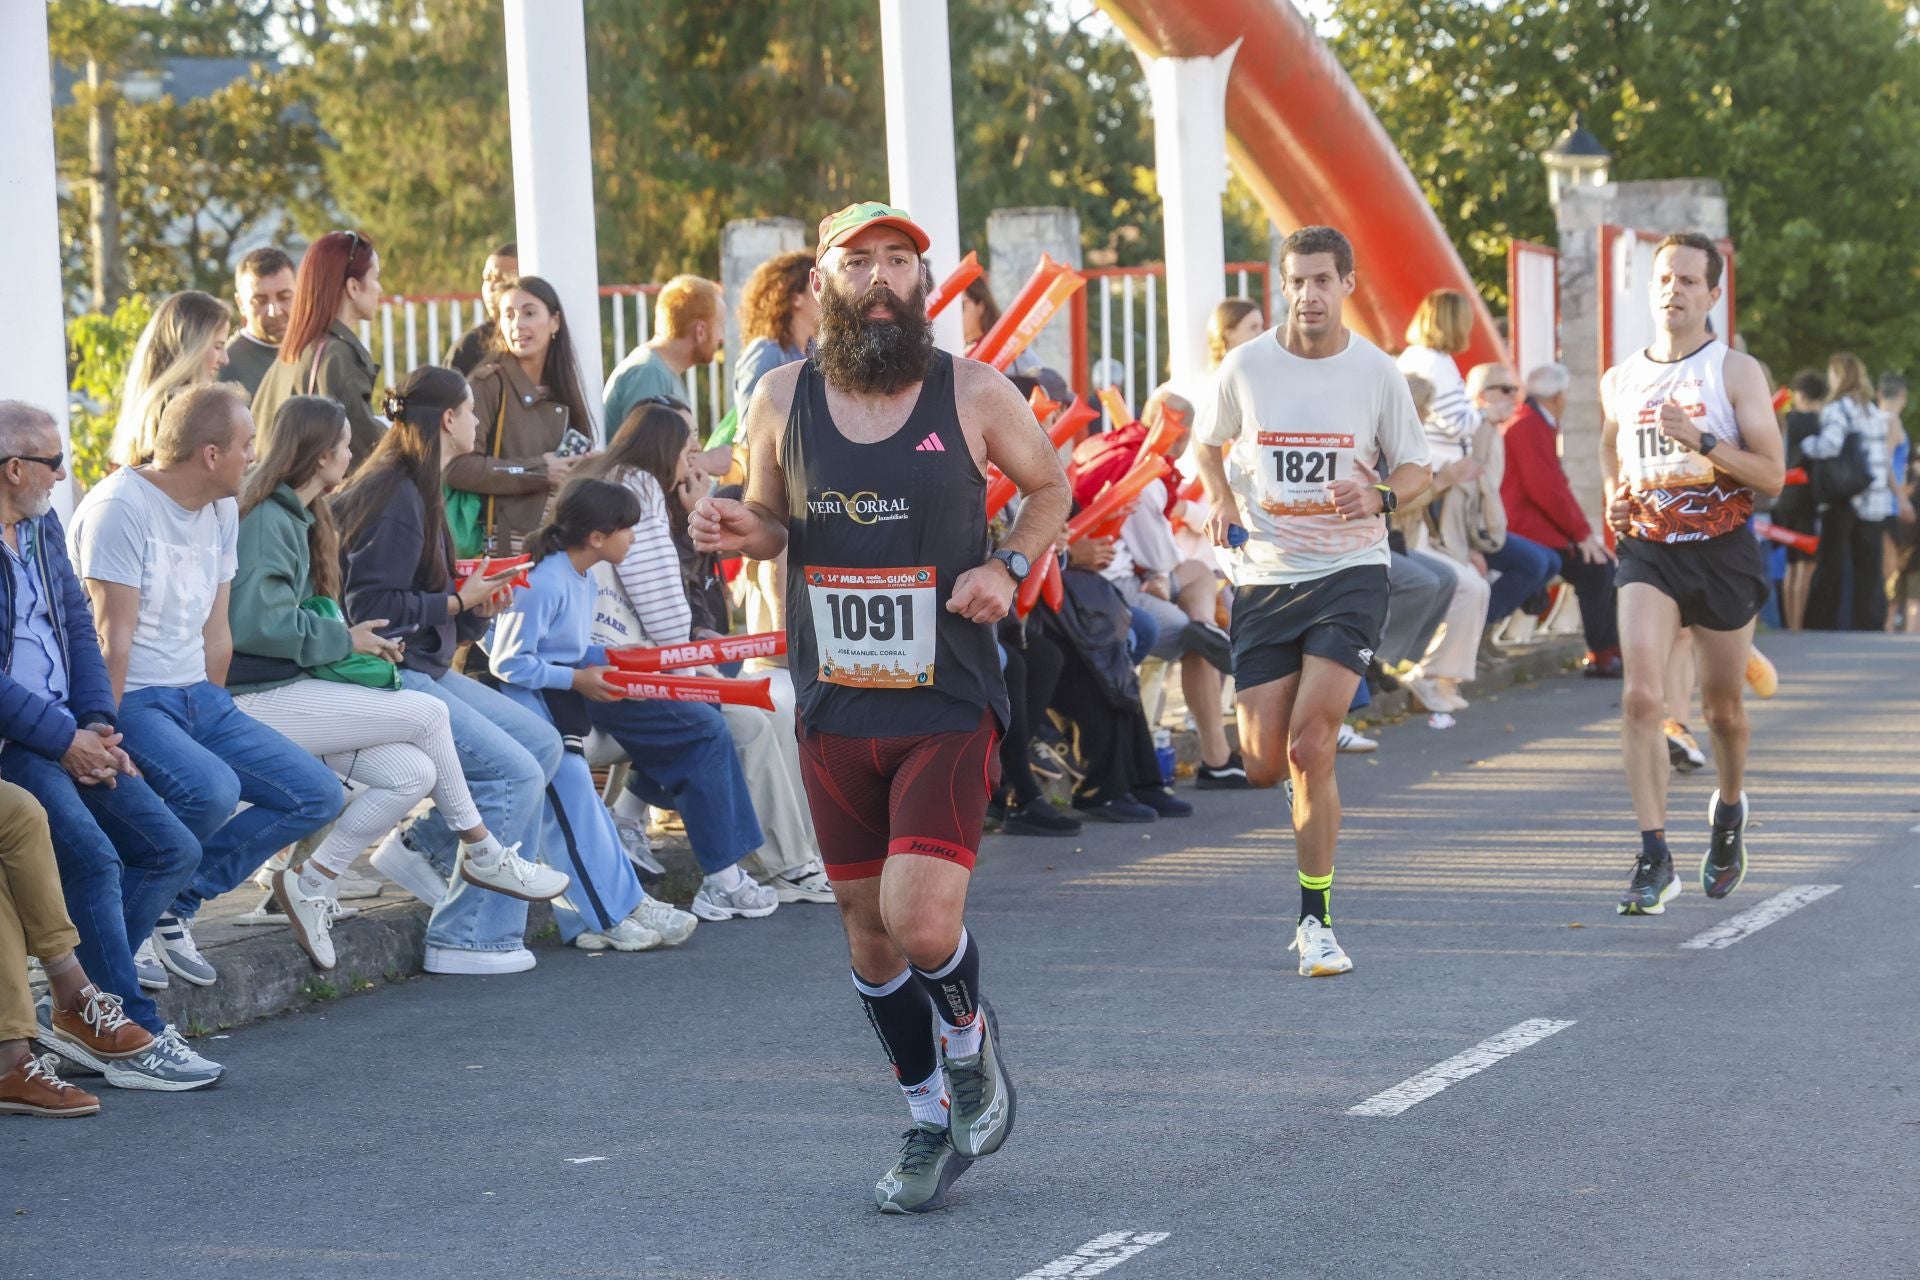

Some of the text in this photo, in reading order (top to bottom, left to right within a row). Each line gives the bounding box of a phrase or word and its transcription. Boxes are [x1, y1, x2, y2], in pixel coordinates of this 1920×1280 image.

[1636, 427, 1691, 458] 119
[1273, 451, 1337, 483] 1821
[807, 498, 909, 514] VERI CORRAL
[840, 575, 865, 584] MBA
[826, 594, 914, 641] 1091
[660, 643, 715, 665] MBA
[628, 683, 671, 699] MBA
